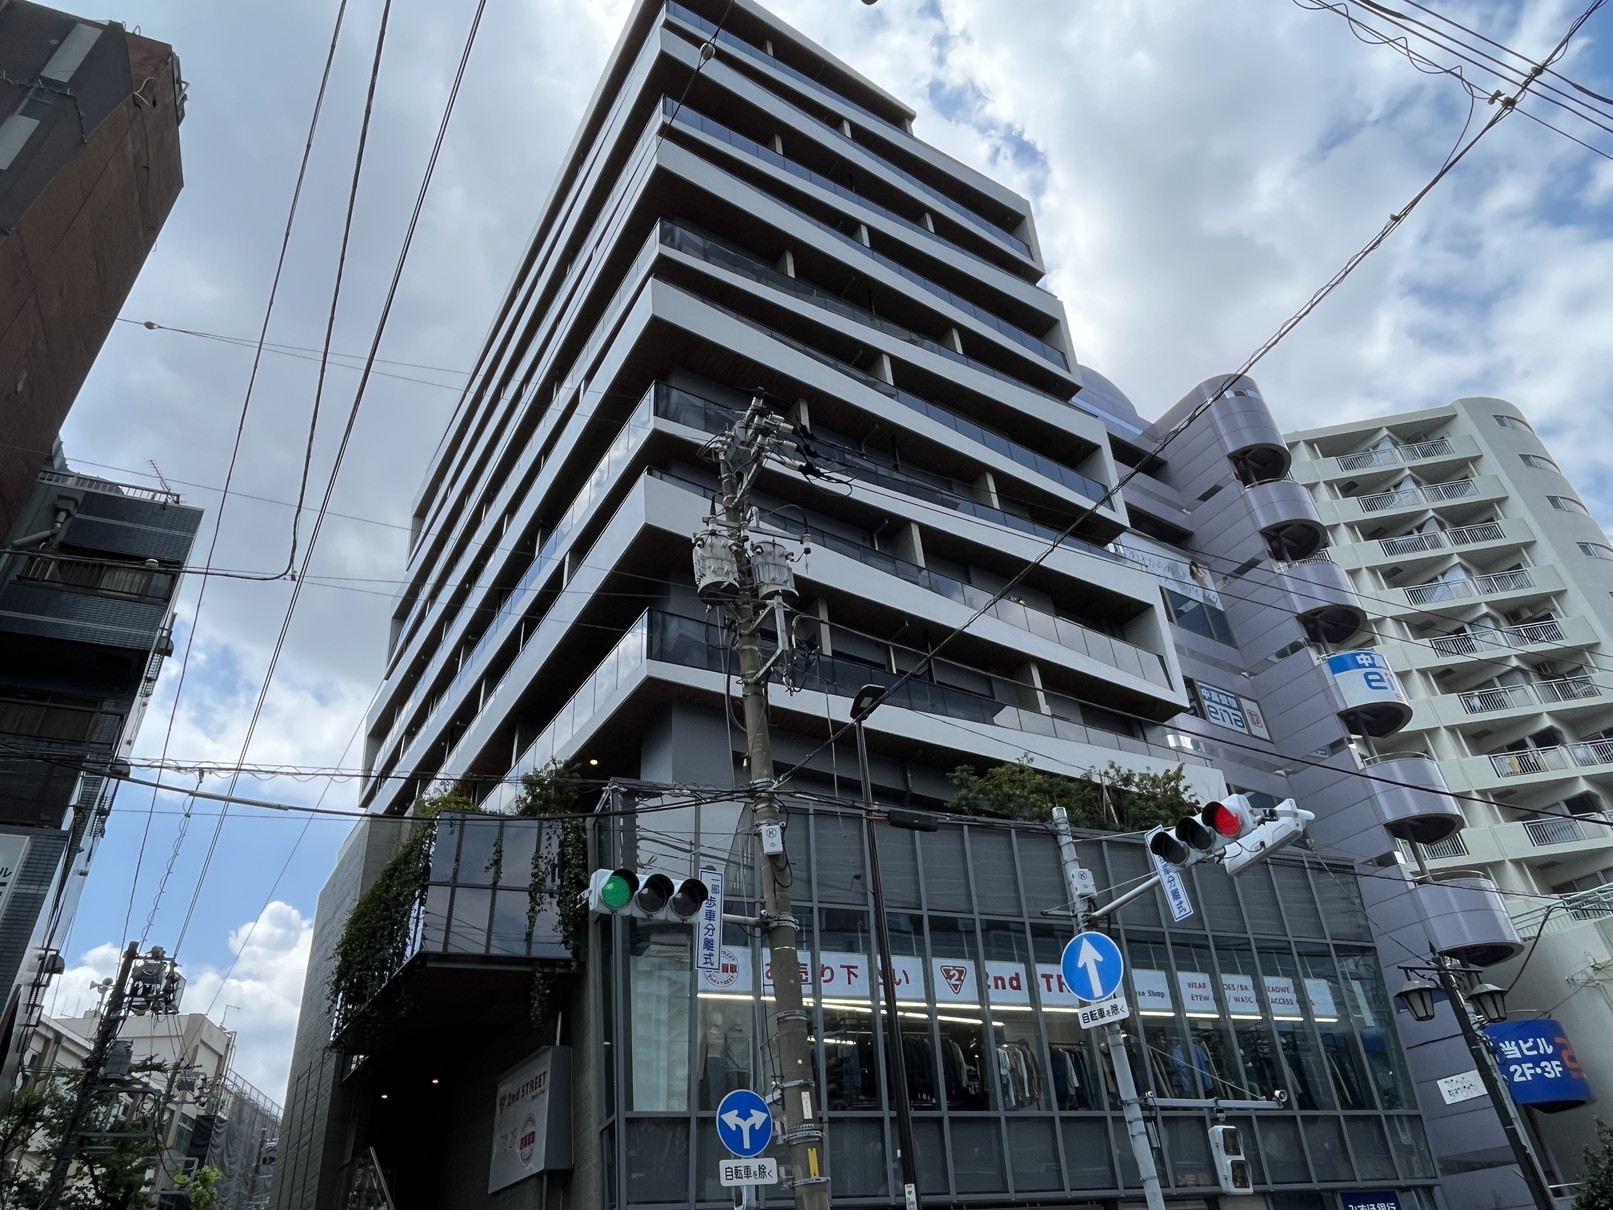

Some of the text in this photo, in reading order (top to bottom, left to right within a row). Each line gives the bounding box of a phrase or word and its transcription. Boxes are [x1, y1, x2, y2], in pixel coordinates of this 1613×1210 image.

[1082, 1003, 1126, 1024] 自転車を除く
[1499, 1038, 1553, 1058] 当ビル
[521, 1071, 547, 1098] STREET
[725, 1164, 773, 1180] 自転車を除く
